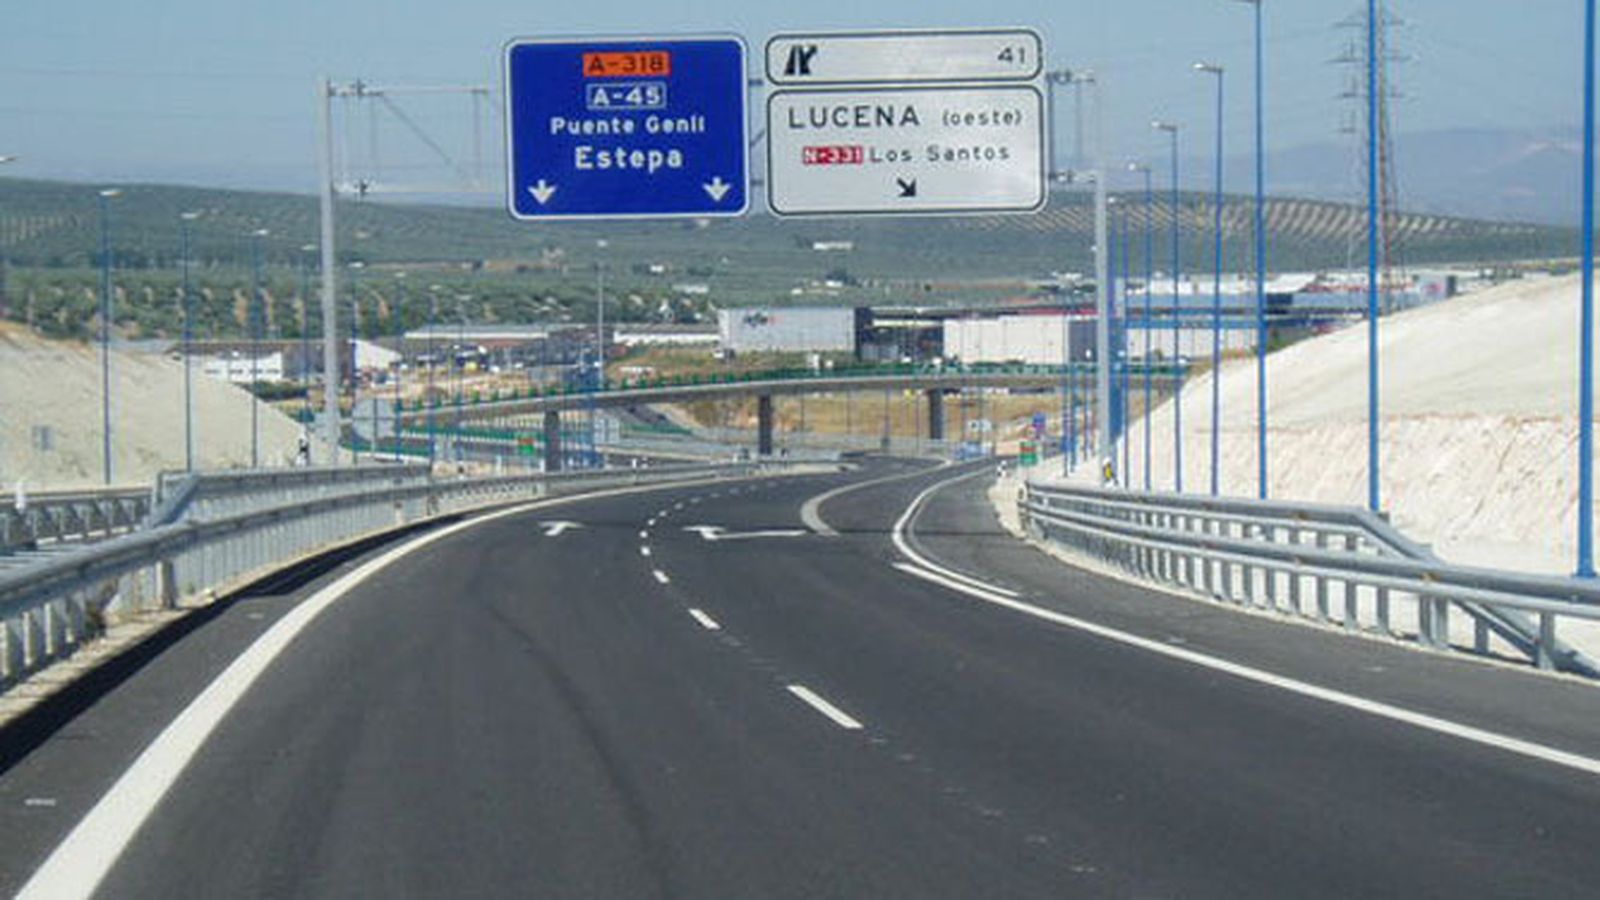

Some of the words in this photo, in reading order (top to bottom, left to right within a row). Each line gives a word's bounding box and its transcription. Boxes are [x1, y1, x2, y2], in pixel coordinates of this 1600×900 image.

[587, 53, 665, 73] A-318
[997, 46, 1027, 63] 41
[592, 85, 661, 107] A-45
[550, 116, 635, 135] Puente
[644, 115, 705, 134] Genil
[787, 105, 921, 129] LUCENA
[941, 108, 1023, 127] (oeste)
[574, 145, 684, 174] Estepa
[803, 147, 864, 164] N-331
[869, 147, 913, 163] Los
[926, 144, 1011, 162] Santos
